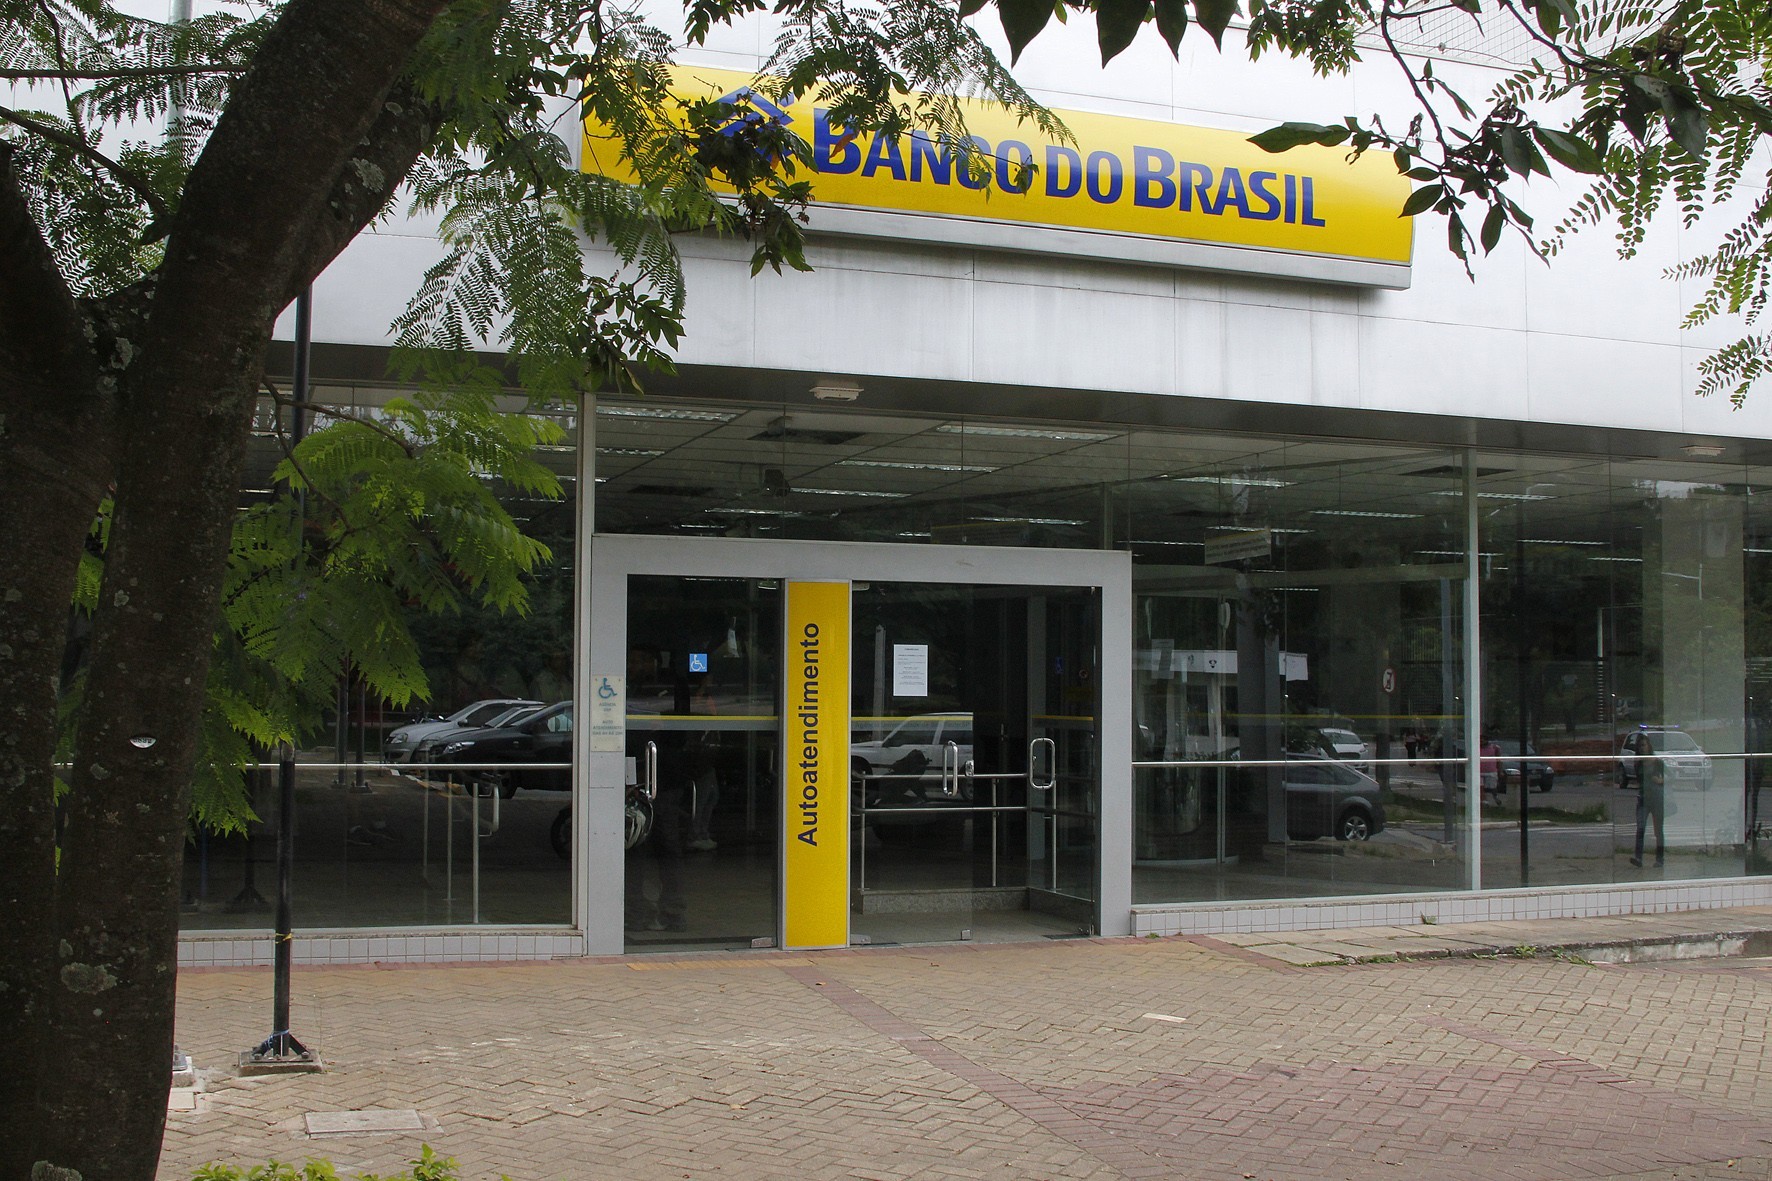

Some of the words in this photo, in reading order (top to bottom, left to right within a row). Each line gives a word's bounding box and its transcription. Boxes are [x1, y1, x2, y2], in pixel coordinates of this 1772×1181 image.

[813, 108, 1034, 194] BANCO
[1045, 145, 1123, 204] DO
[1133, 145, 1326, 228] BRASIL
[797, 622, 820, 847] Autoatendimento
